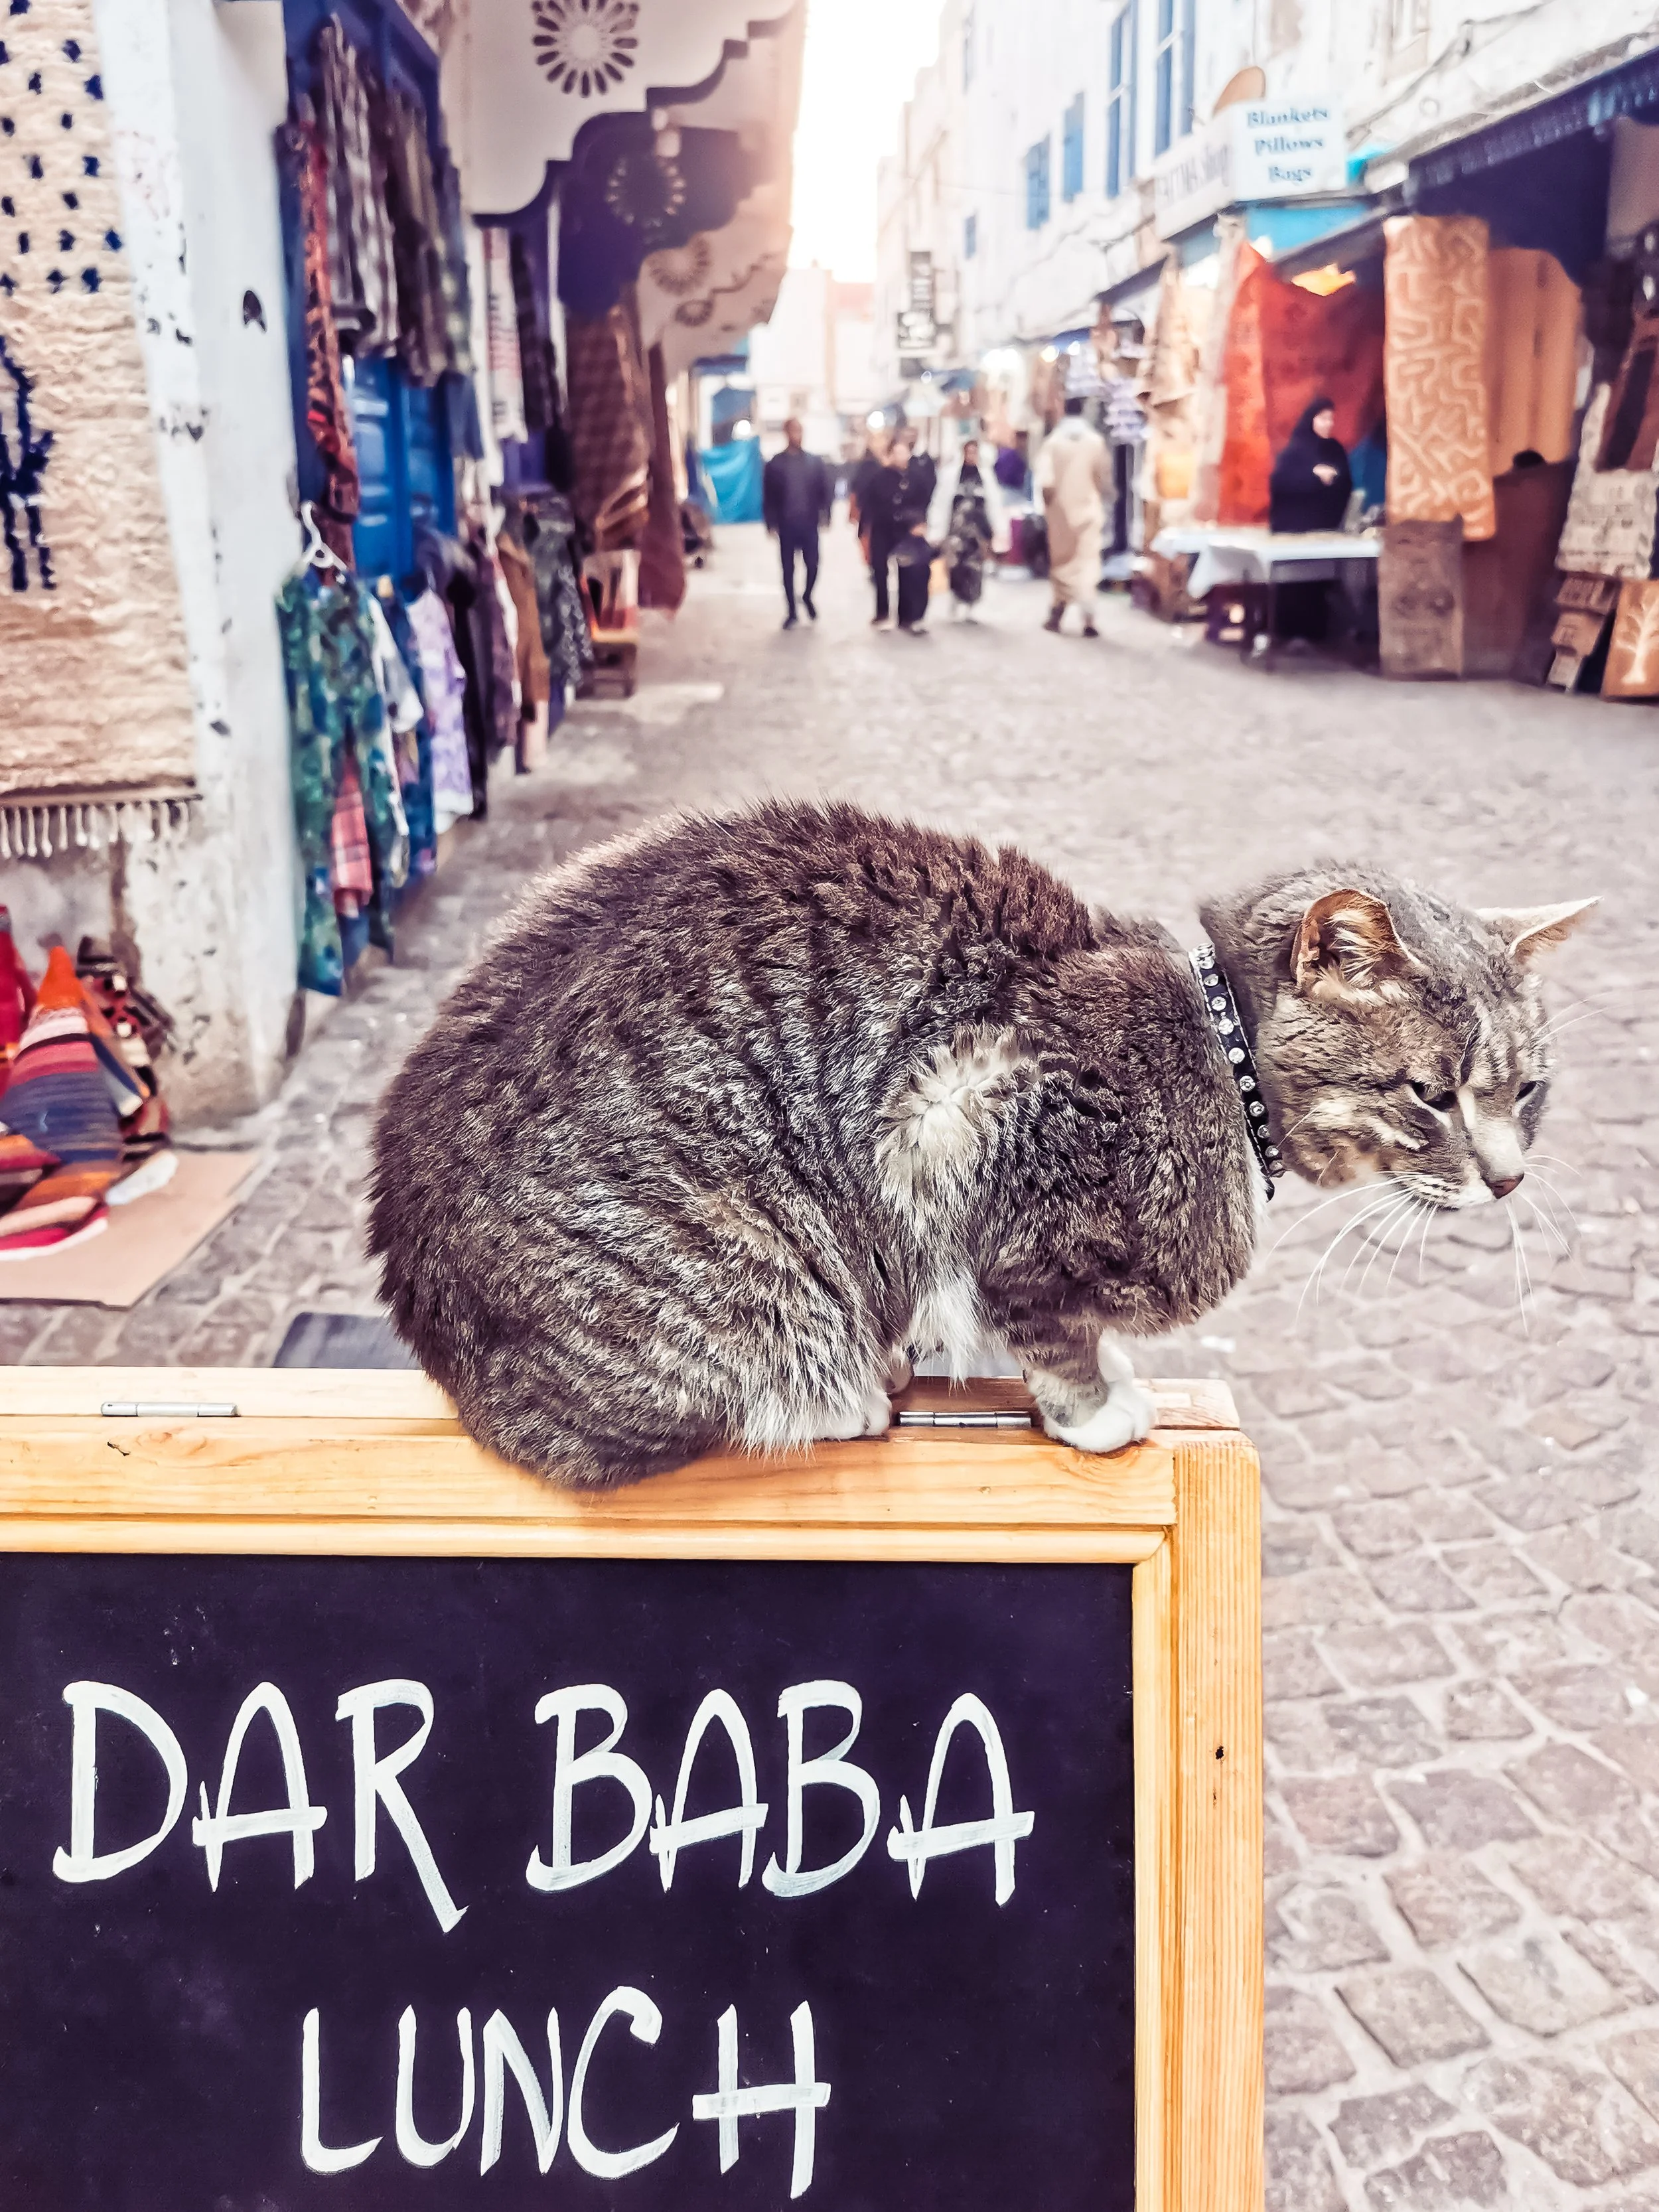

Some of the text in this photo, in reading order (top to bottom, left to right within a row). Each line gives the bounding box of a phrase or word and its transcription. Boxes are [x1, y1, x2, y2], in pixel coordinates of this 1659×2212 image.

[1247, 107, 1328, 127] Blankets
[1254, 137, 1323, 155] Pillows
[52, 1679, 1035, 1933] DAR BABA
[301, 1986, 831, 2199] LUNCH
